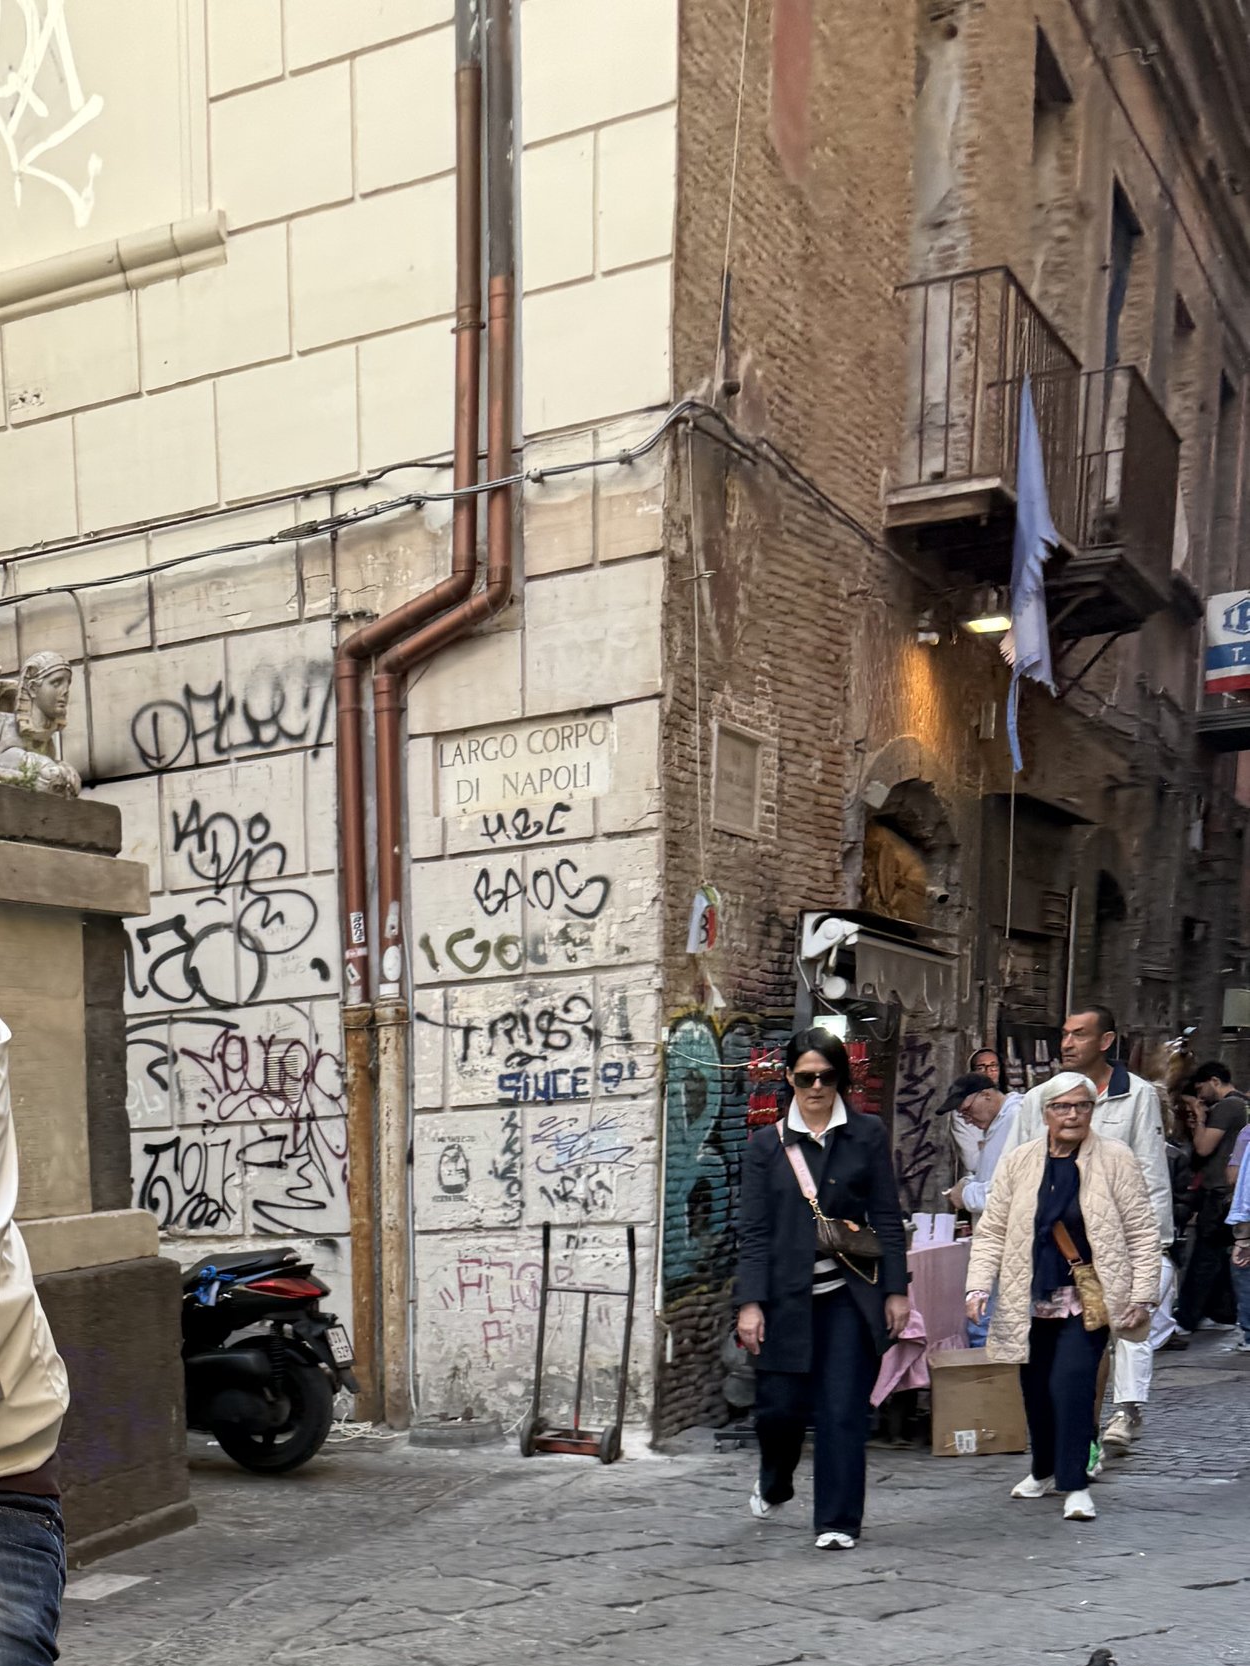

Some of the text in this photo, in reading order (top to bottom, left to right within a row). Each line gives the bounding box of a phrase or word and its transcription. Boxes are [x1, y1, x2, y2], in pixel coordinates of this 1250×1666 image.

[439, 720, 607, 769] LARGO CORPO
[456, 761, 591, 805] DI NAPOLI
